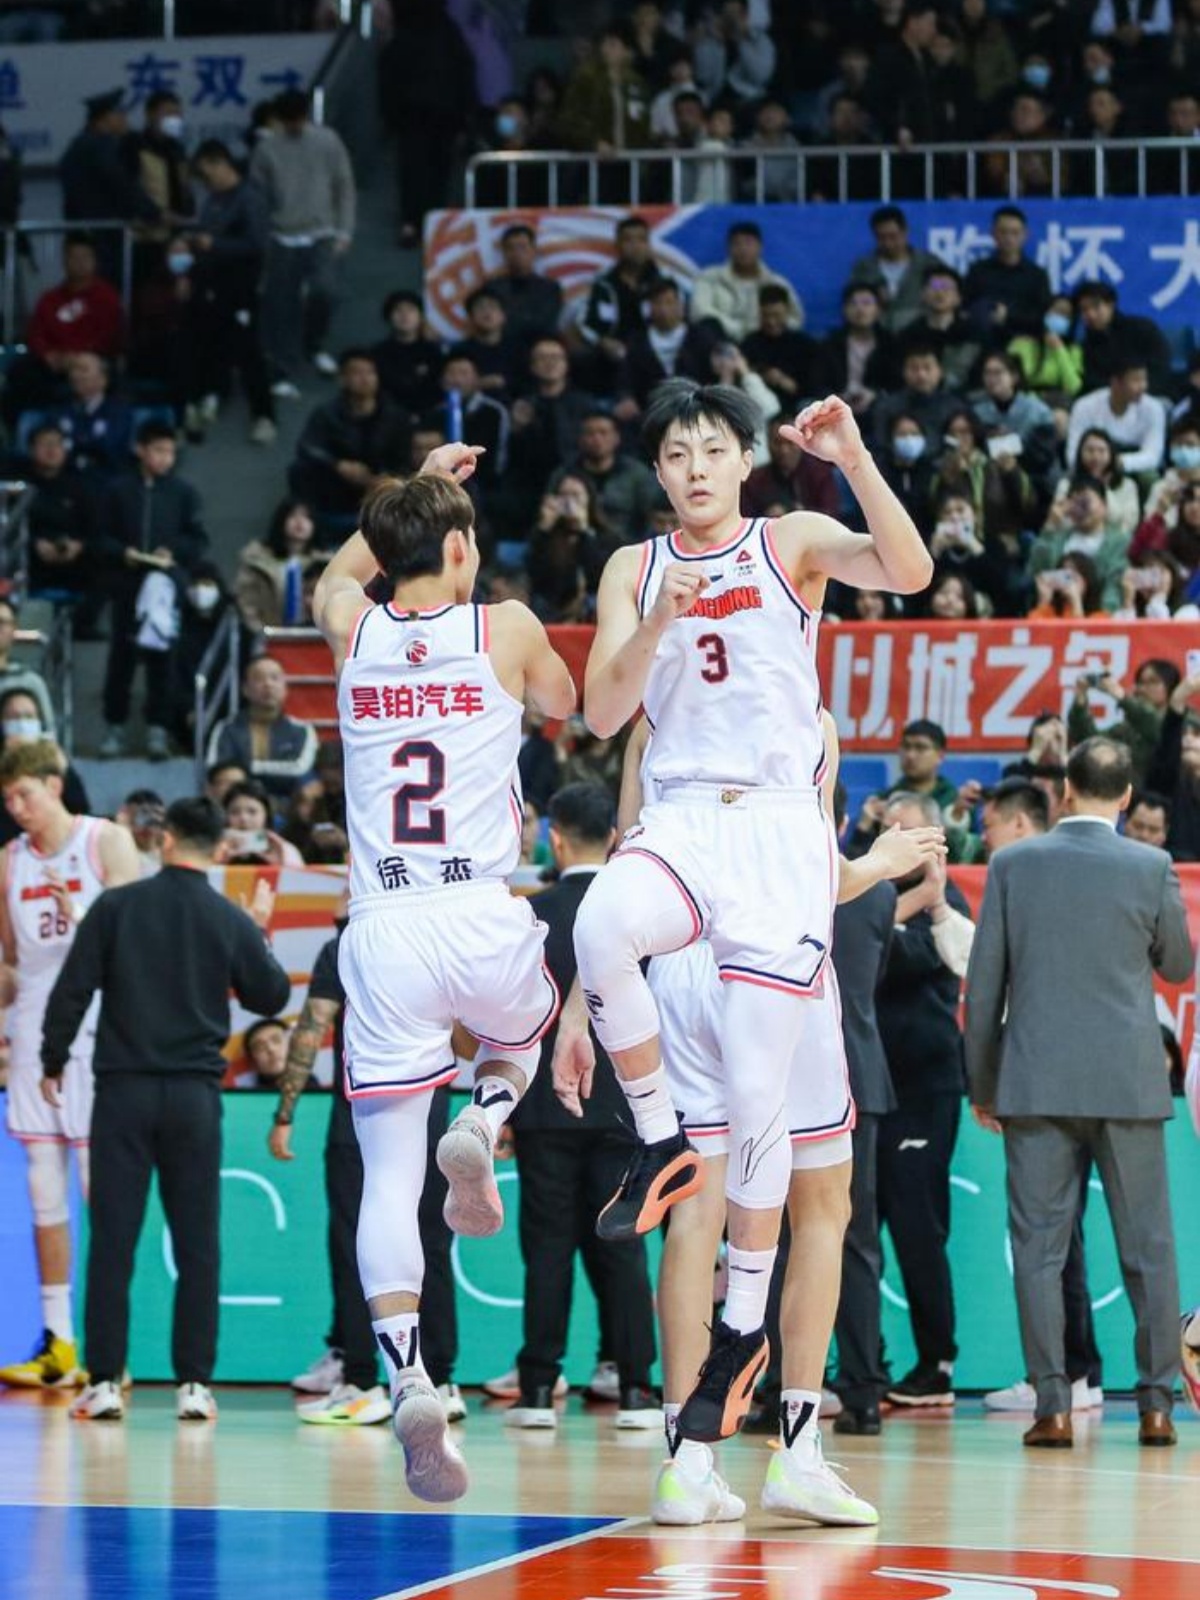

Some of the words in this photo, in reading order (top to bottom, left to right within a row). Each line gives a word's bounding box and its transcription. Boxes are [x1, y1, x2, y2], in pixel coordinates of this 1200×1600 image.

[697, 633, 729, 684] 3
[831, 628, 1131, 740] 以城之名
[351, 683, 485, 721] 昊铂汽车
[391, 740, 447, 845] 2
